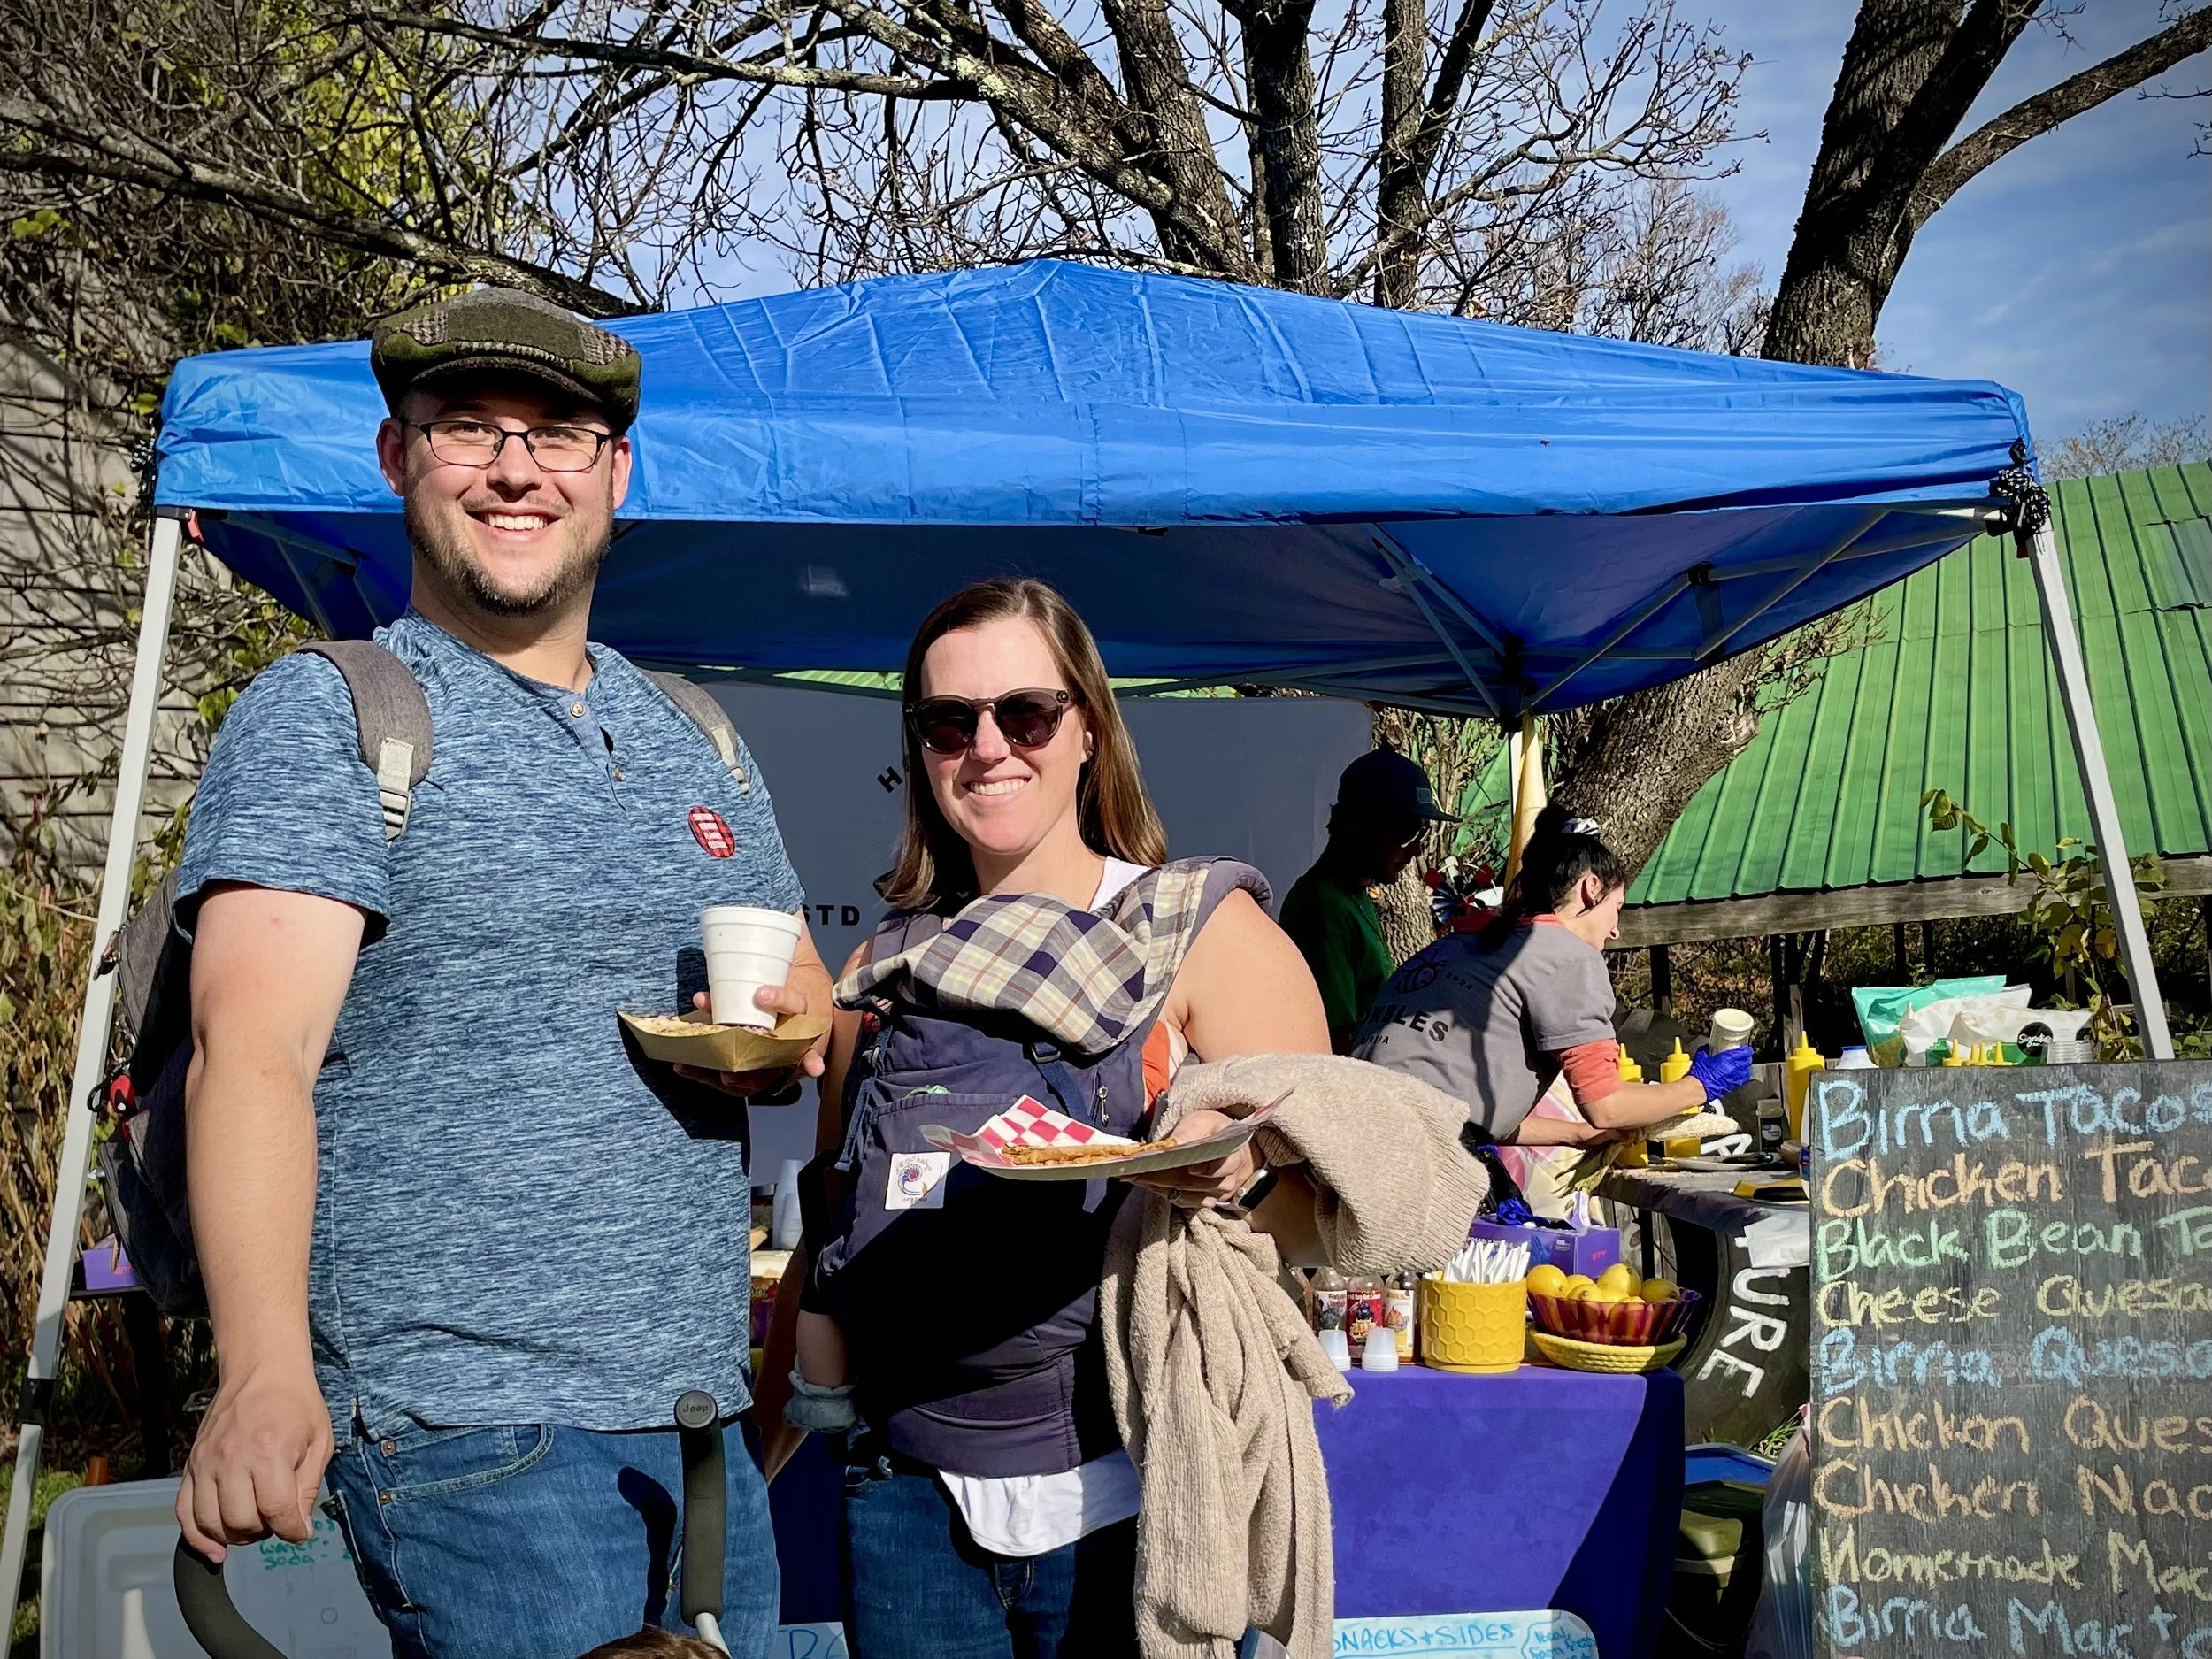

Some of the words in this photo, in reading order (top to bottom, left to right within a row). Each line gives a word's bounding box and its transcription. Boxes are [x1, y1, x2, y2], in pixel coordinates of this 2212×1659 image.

[1821, 1151, 2064, 1218] Chicken
[2080, 1135, 2212, 1204] Tac
[1816, 1217, 1969, 1283] Black
[1986, 1209, 2142, 1271] Bean
[1816, 1280, 2002, 1329] Cheese
[2037, 1273, 2212, 1318] Quesa
